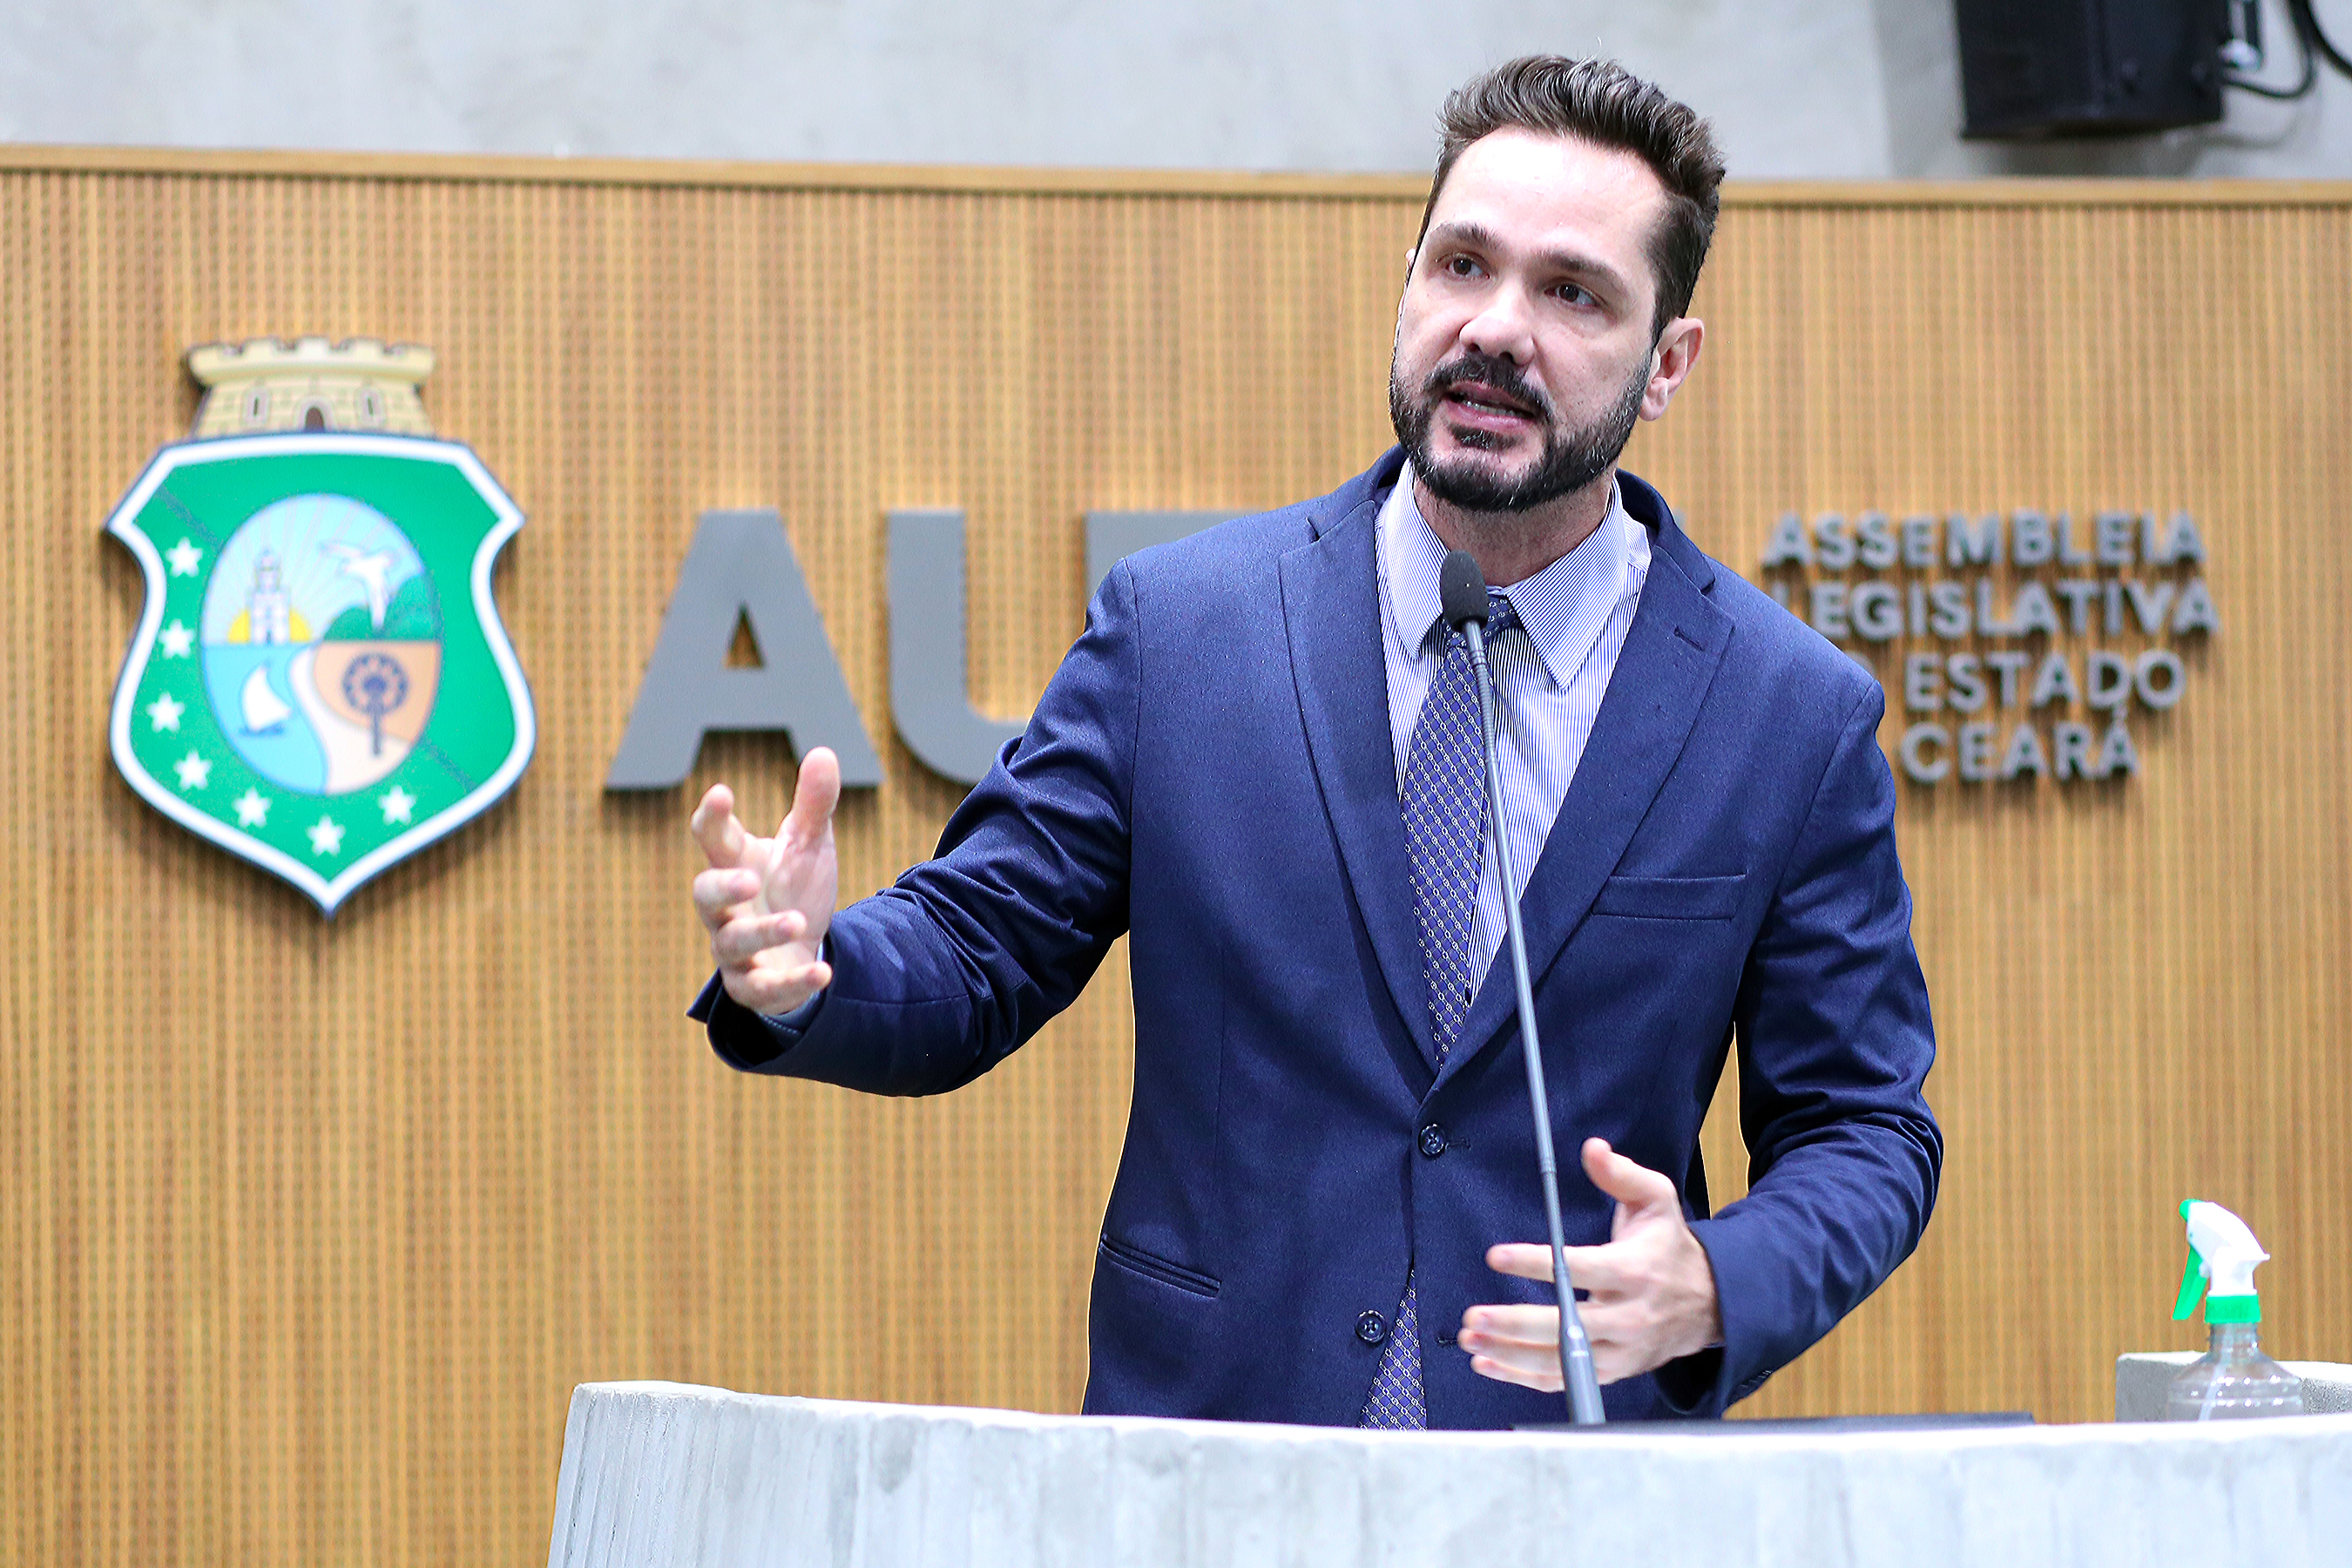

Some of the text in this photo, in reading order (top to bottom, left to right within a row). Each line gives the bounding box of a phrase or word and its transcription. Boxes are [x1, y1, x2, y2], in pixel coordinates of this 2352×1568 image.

[1761, 509, 2206, 570] ASSEMBLEIA
[1904, 649, 2186, 712] ESTADO
[1900, 702, 2139, 783] CEARÁ
